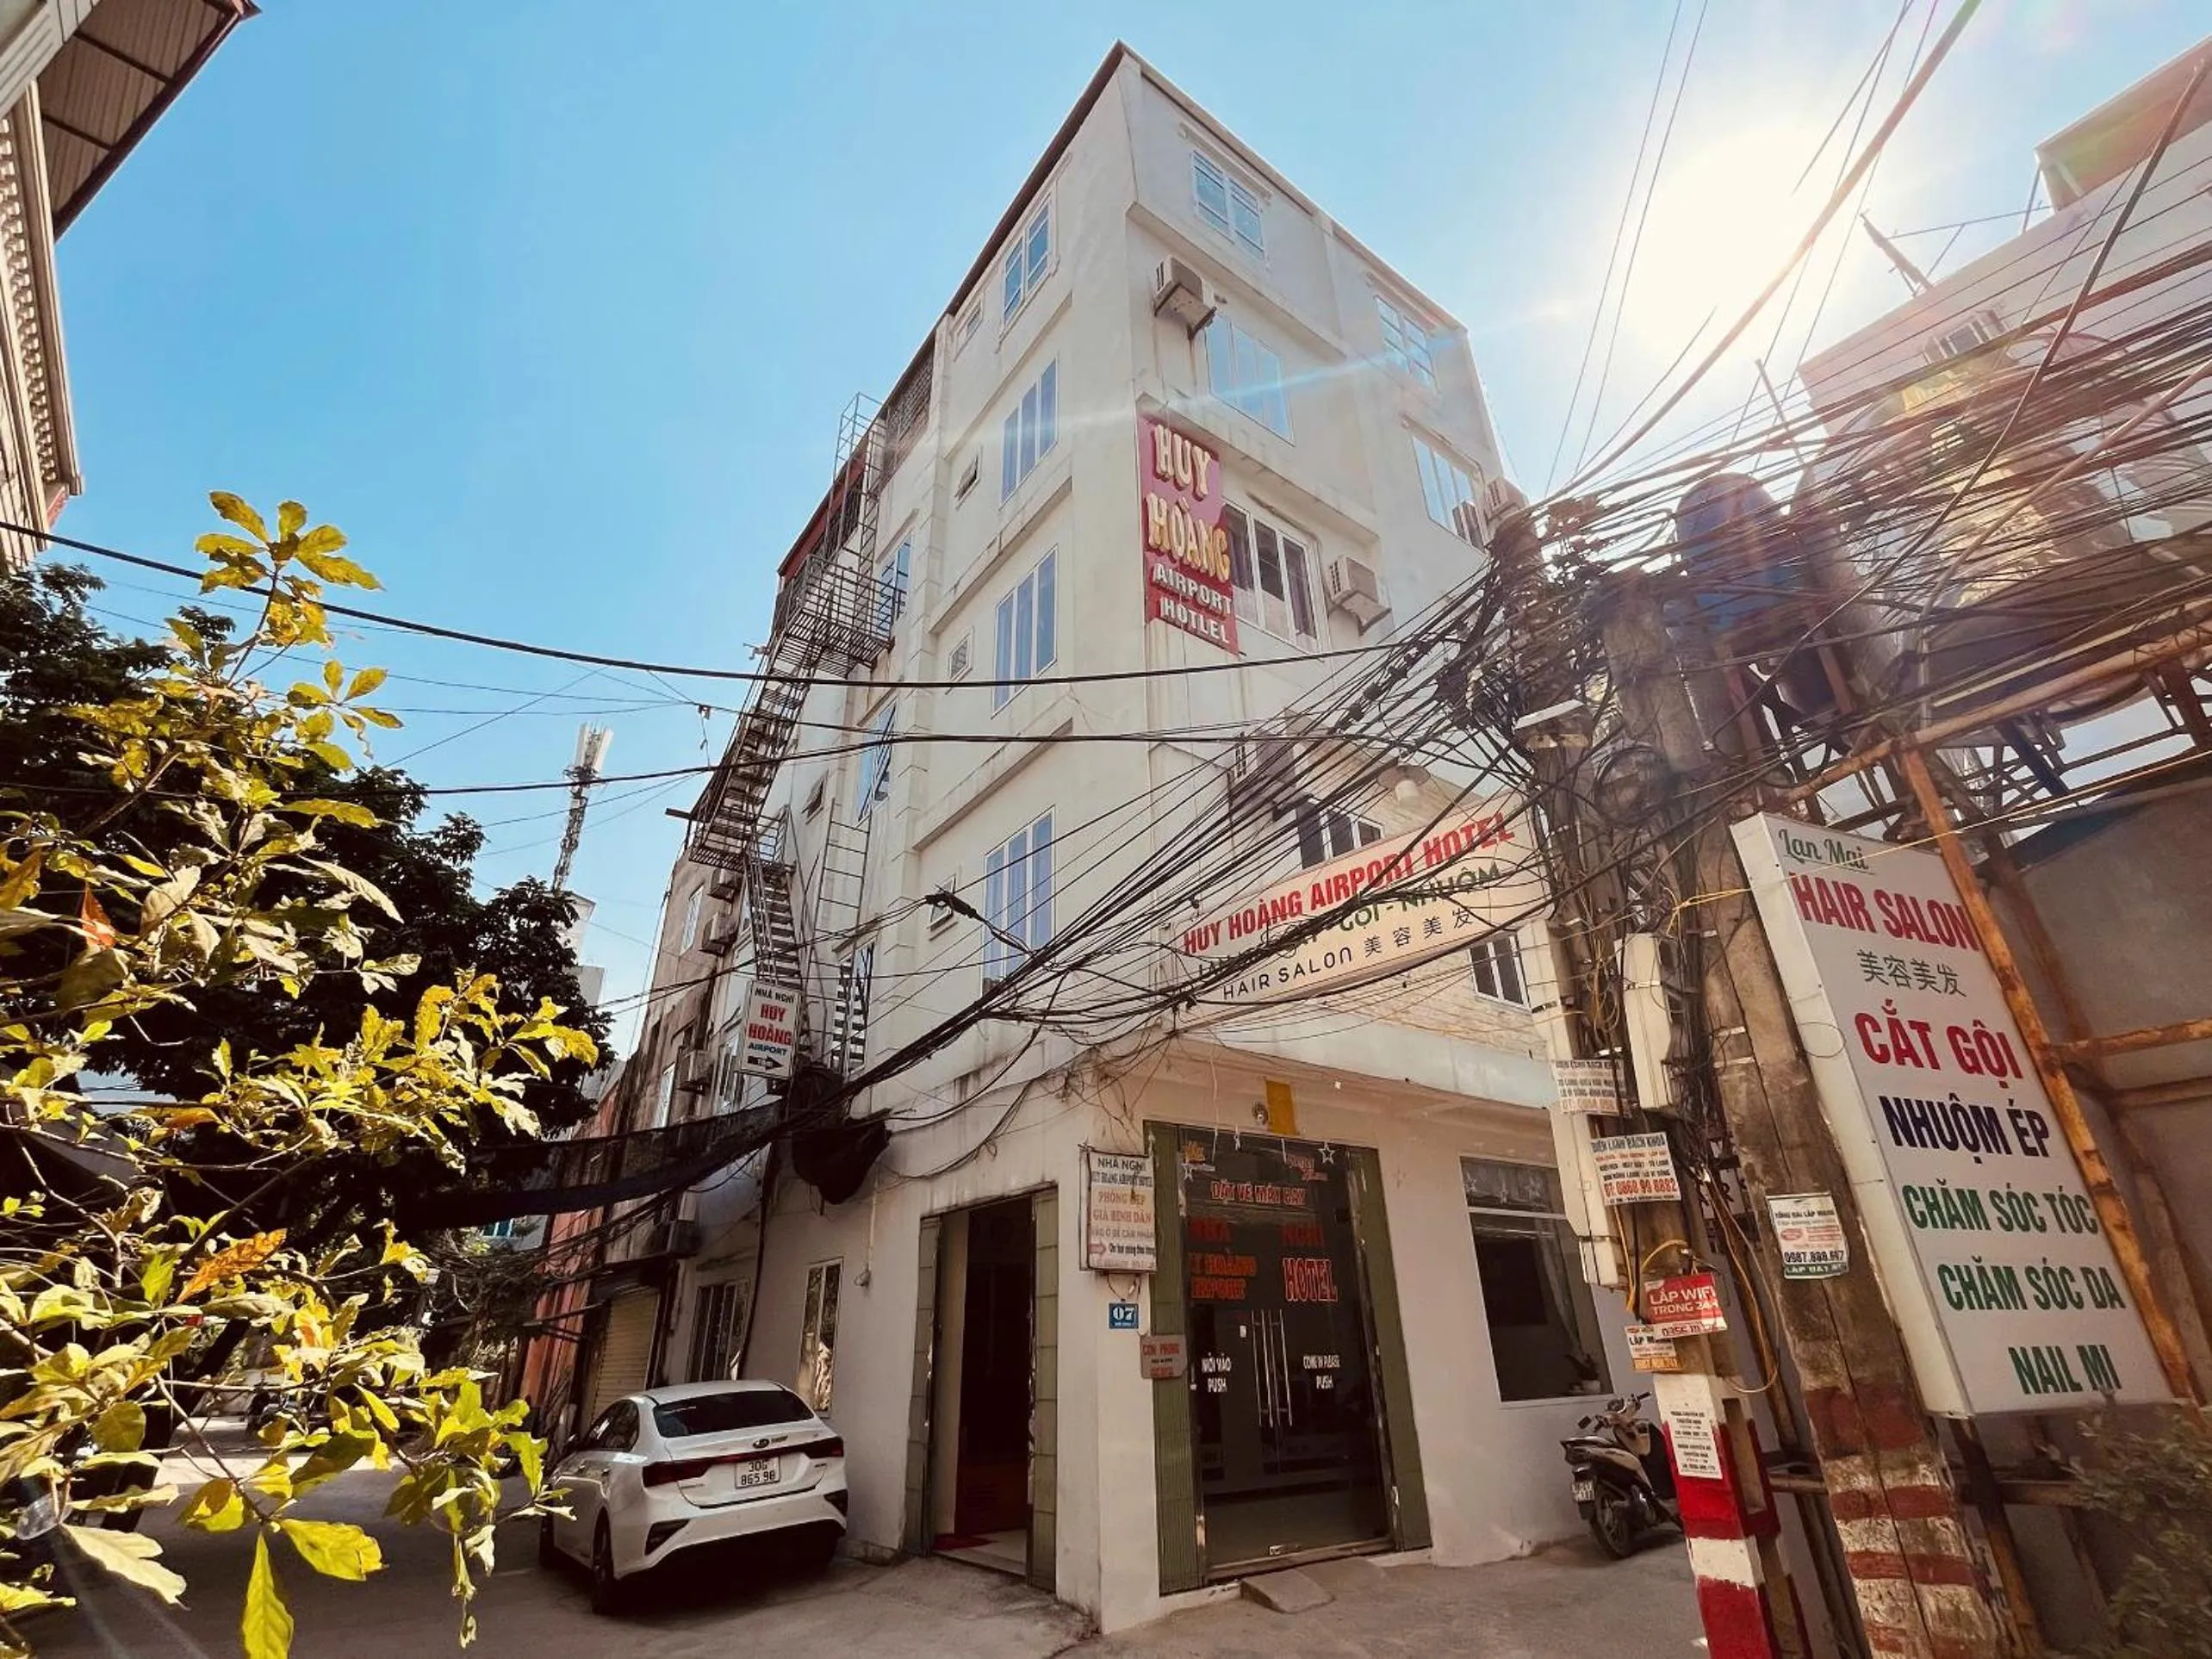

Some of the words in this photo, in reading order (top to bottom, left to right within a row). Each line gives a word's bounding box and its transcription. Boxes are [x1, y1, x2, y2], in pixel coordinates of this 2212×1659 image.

[1154, 423, 1212, 498] HUY
[1152, 562, 1233, 614] AIRPORT
[1779, 828, 1823, 864] Lan
[1824, 838, 1869, 870] Mai
[1183, 920, 1221, 954] HUY
[1227, 890, 1303, 940] HOÀNG
[1310, 853, 1414, 911] AIRPORT
[1788, 872, 1877, 933] HAIR
[1873, 888, 1980, 952] SALON
[1223, 974, 1271, 1000] HAIR
[1856, 948, 1967, 998] 美容美发
[1855, 998, 1941, 1071] CẮT
[1947, 1021, 2024, 1089] GỘI
[1878, 1092, 2013, 1165] NHUỘM
[2005, 1098, 2050, 1158] ÉP
[1902, 1177, 1991, 1232] CHĂM
[1989, 1182, 2047, 1233] SÓC
[2042, 1185, 2099, 1234] TÓC
[1283, 1258, 1339, 1302] HOTEL
[1936, 1255, 2028, 1311] CHĂM
[2024, 1257, 2085, 1311] SÓC
[2079, 1266, 2126, 1310] DA
[1112, 1307, 1135, 1320] 07
[1653, 1302, 1694, 1315] TRONG
[1208, 1377, 1227, 1393] PUSH
[1316, 1376, 1334, 1389] PUSH
[2008, 1345, 2084, 1395] NAIL
[2076, 1344, 2122, 1391] MI
